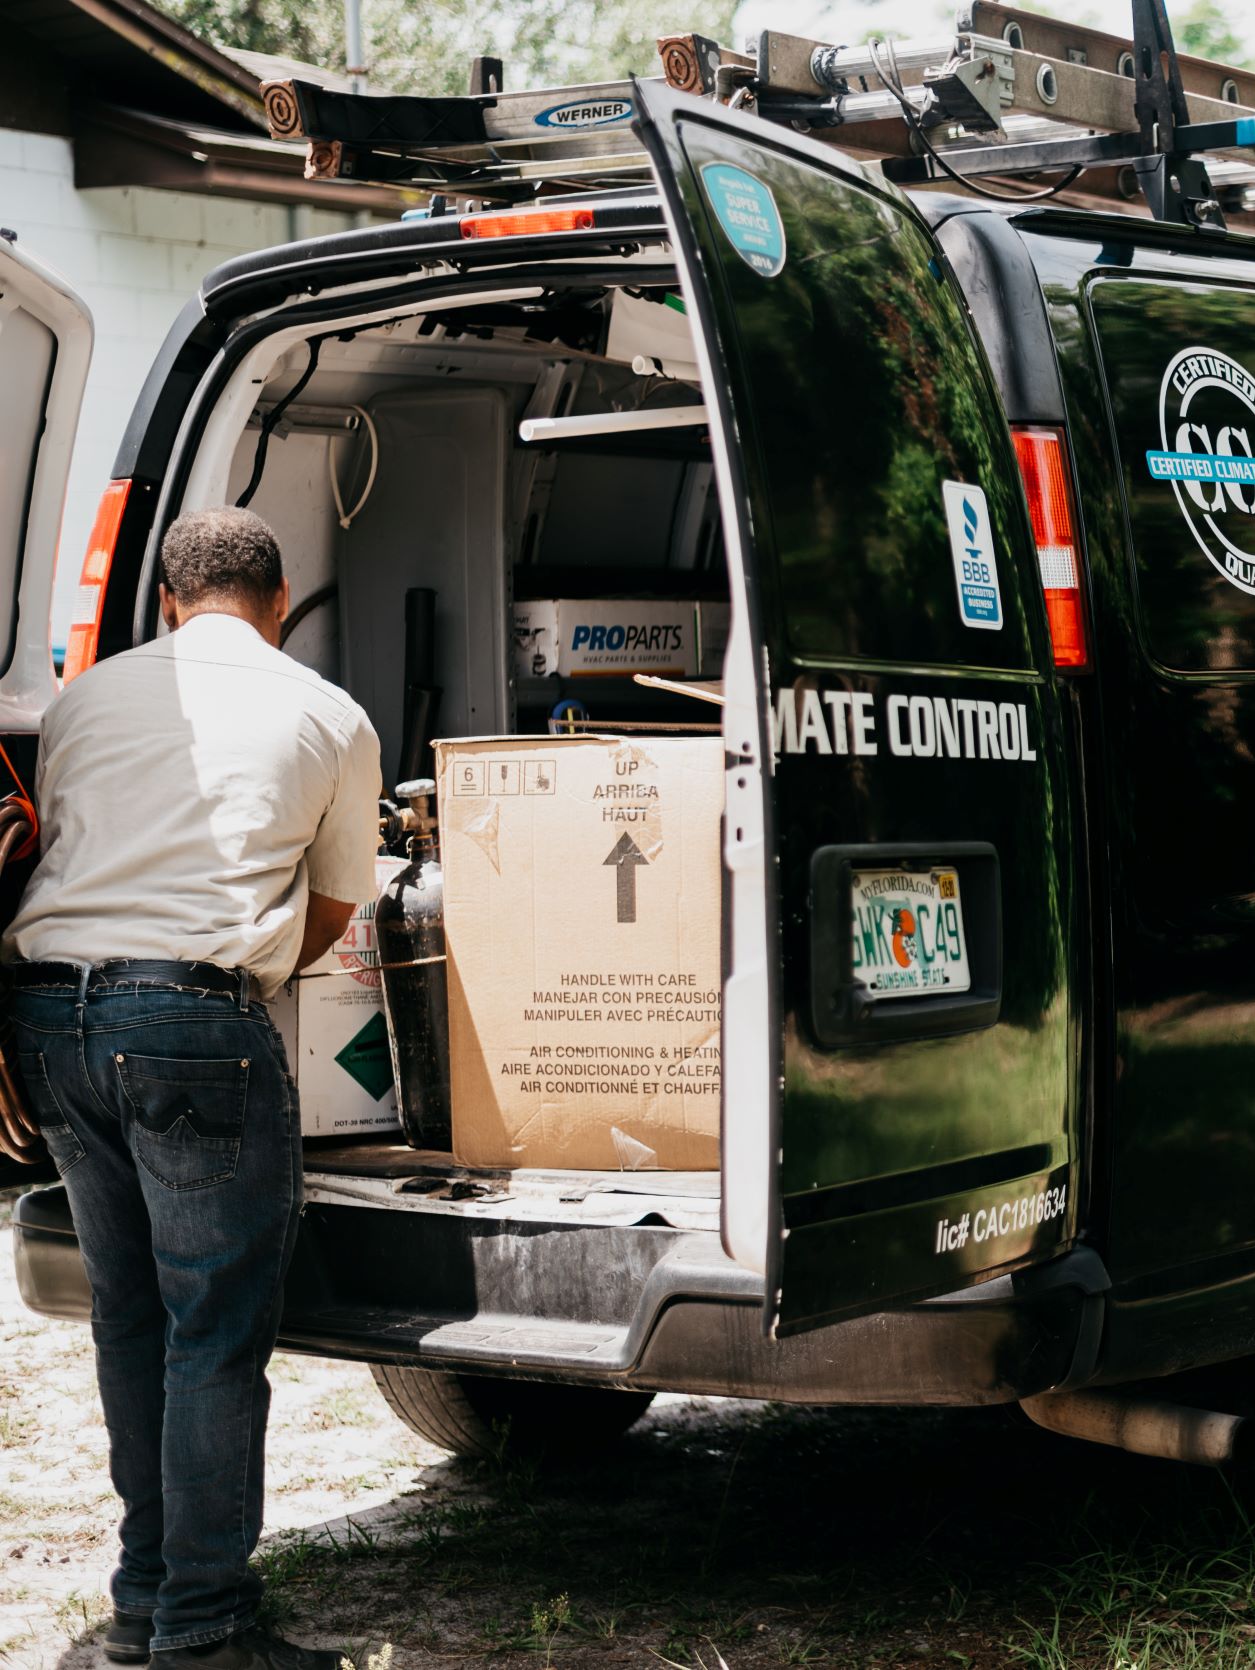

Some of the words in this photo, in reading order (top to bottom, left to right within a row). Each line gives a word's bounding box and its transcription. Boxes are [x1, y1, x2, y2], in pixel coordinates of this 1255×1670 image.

[557, 104, 624, 122] WERNER
[726, 192, 761, 214] SUPER
[726, 209, 770, 232] SERVICE
[1150, 456, 1213, 478] CERTIFIED
[962, 561, 990, 584] BBB
[572, 625, 683, 652] PROPARTS
[583, 654, 602, 664] HVAC
[604, 654, 628, 664] PARTS
[638, 654, 672, 663] SUPPLIES
[771, 688, 878, 756] MATE
[886, 694, 1037, 762] CONTROL
[464, 767, 474, 782] 6
[616, 761, 639, 776] UP
[602, 807, 648, 822] HAUT
[861, 876, 934, 900] MYFLORIDA.COM
[916, 902, 962, 963] C49
[560, 974, 616, 986] HANDLE
[619, 974, 654, 986] WITH
[658, 974, 696, 986] CARE
[876, 969, 918, 990] SUNSHINE
[922, 967, 946, 986] STATE
[532, 991, 598, 1004] MANEJAR
[602, 992, 632, 1004] CON
[524, 1010, 603, 1022] MANIPULER
[606, 1010, 643, 1022] AVEC
[530, 1047, 552, 1058] AIR
[555, 1046, 654, 1059] CONDITIONING
[660, 1047, 669, 1058] &
[501, 1064, 532, 1076] AIRE
[536, 1064, 650, 1076] ACONDICIONADO
[654, 1064, 663, 1076] Y
[668, 1064, 721, 1076] CALEFA
[520, 1082, 542, 1094] AIR
[546, 1078, 638, 1094] CONDITIONNÉ
[643, 1082, 660, 1094] ET
[664, 1082, 721, 1095] CHAUFF
[935, 1213, 970, 1254] lic#
[973, 1184, 1066, 1242] CAC1816634
